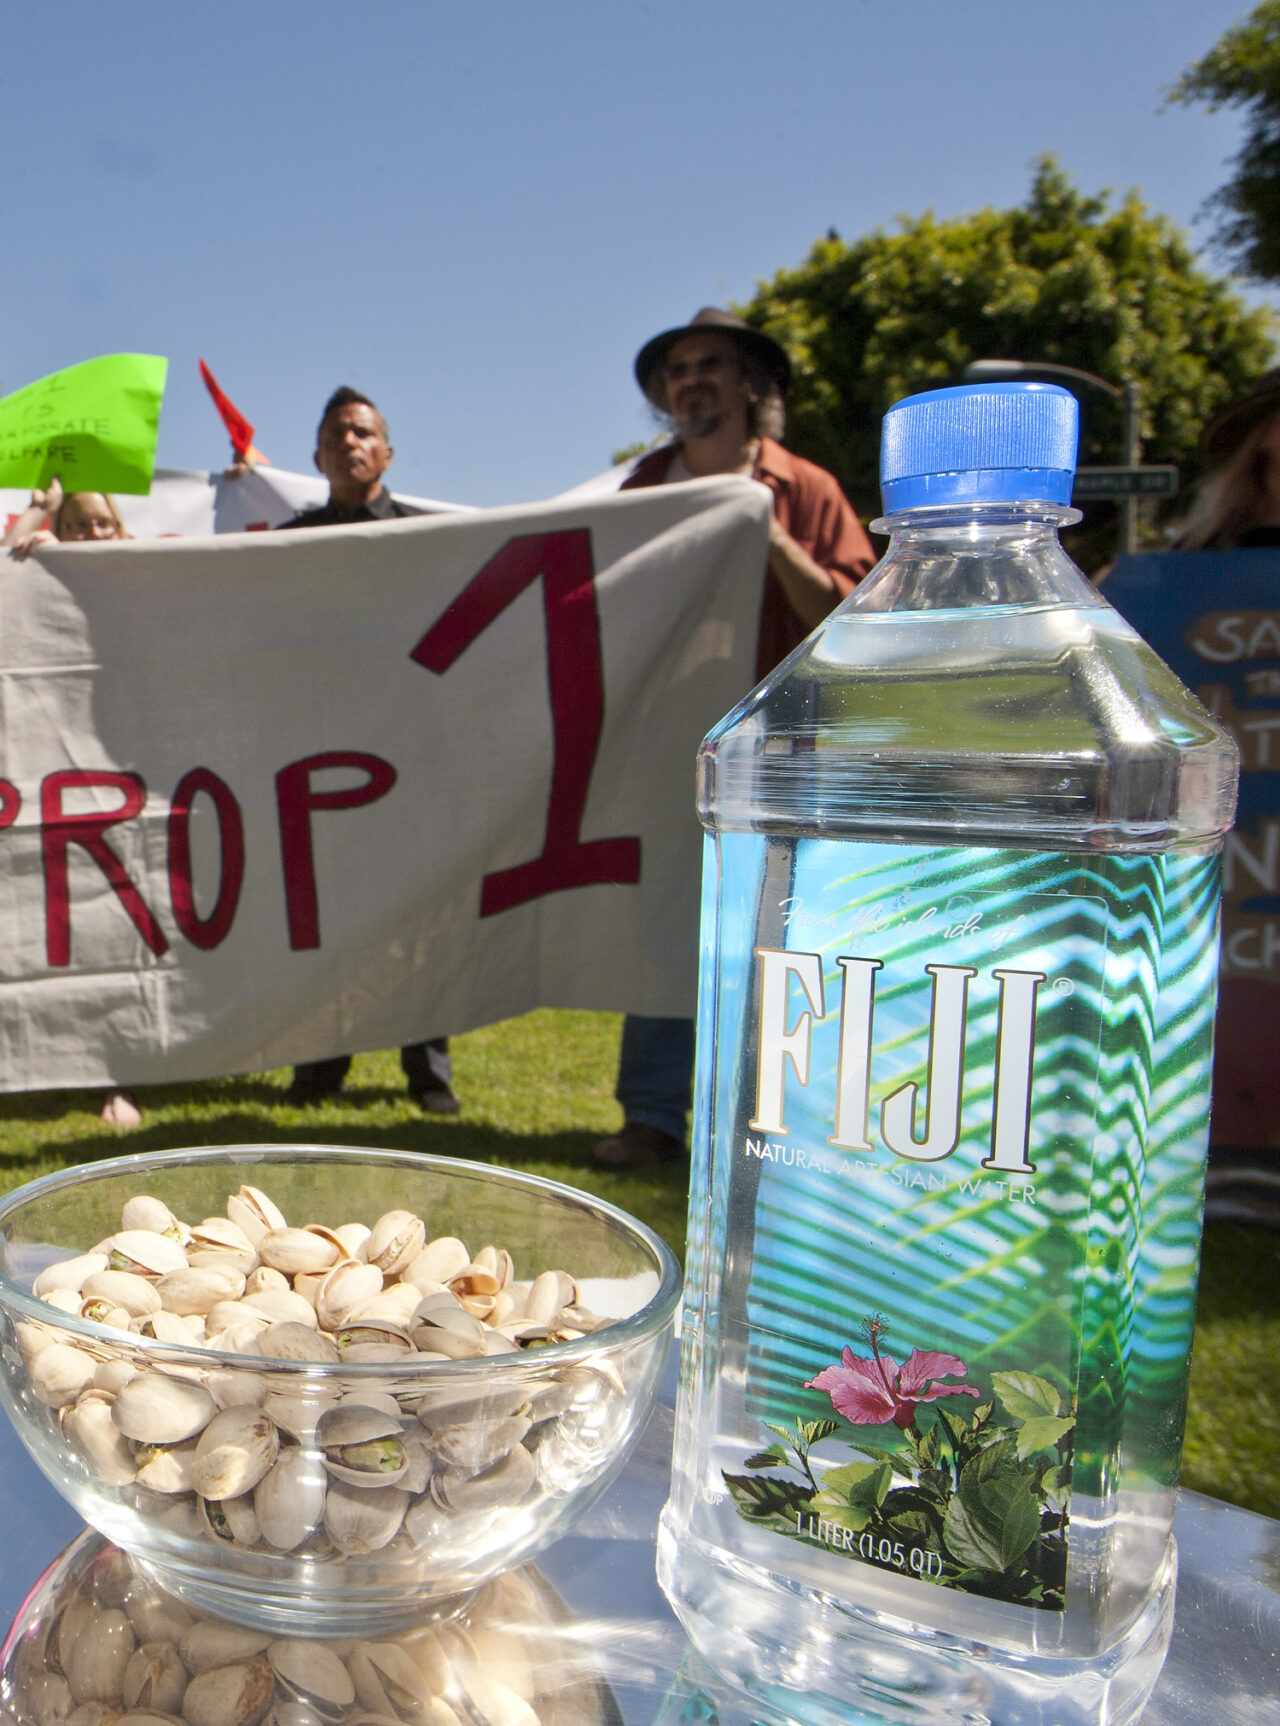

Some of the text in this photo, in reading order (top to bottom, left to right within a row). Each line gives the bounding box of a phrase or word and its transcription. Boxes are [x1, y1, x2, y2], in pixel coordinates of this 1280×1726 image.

[1192, 616, 1280, 664] SA
[408, 526, 643, 921] 1
[894, 906, 984, 942] islands
[748, 947, 1048, 1175] FIJI
[744, 1137, 1038, 1205] NATURAL ARTESIAN WATER
[794, 1510, 945, 1578] 1 LITER (1.05 QT)
